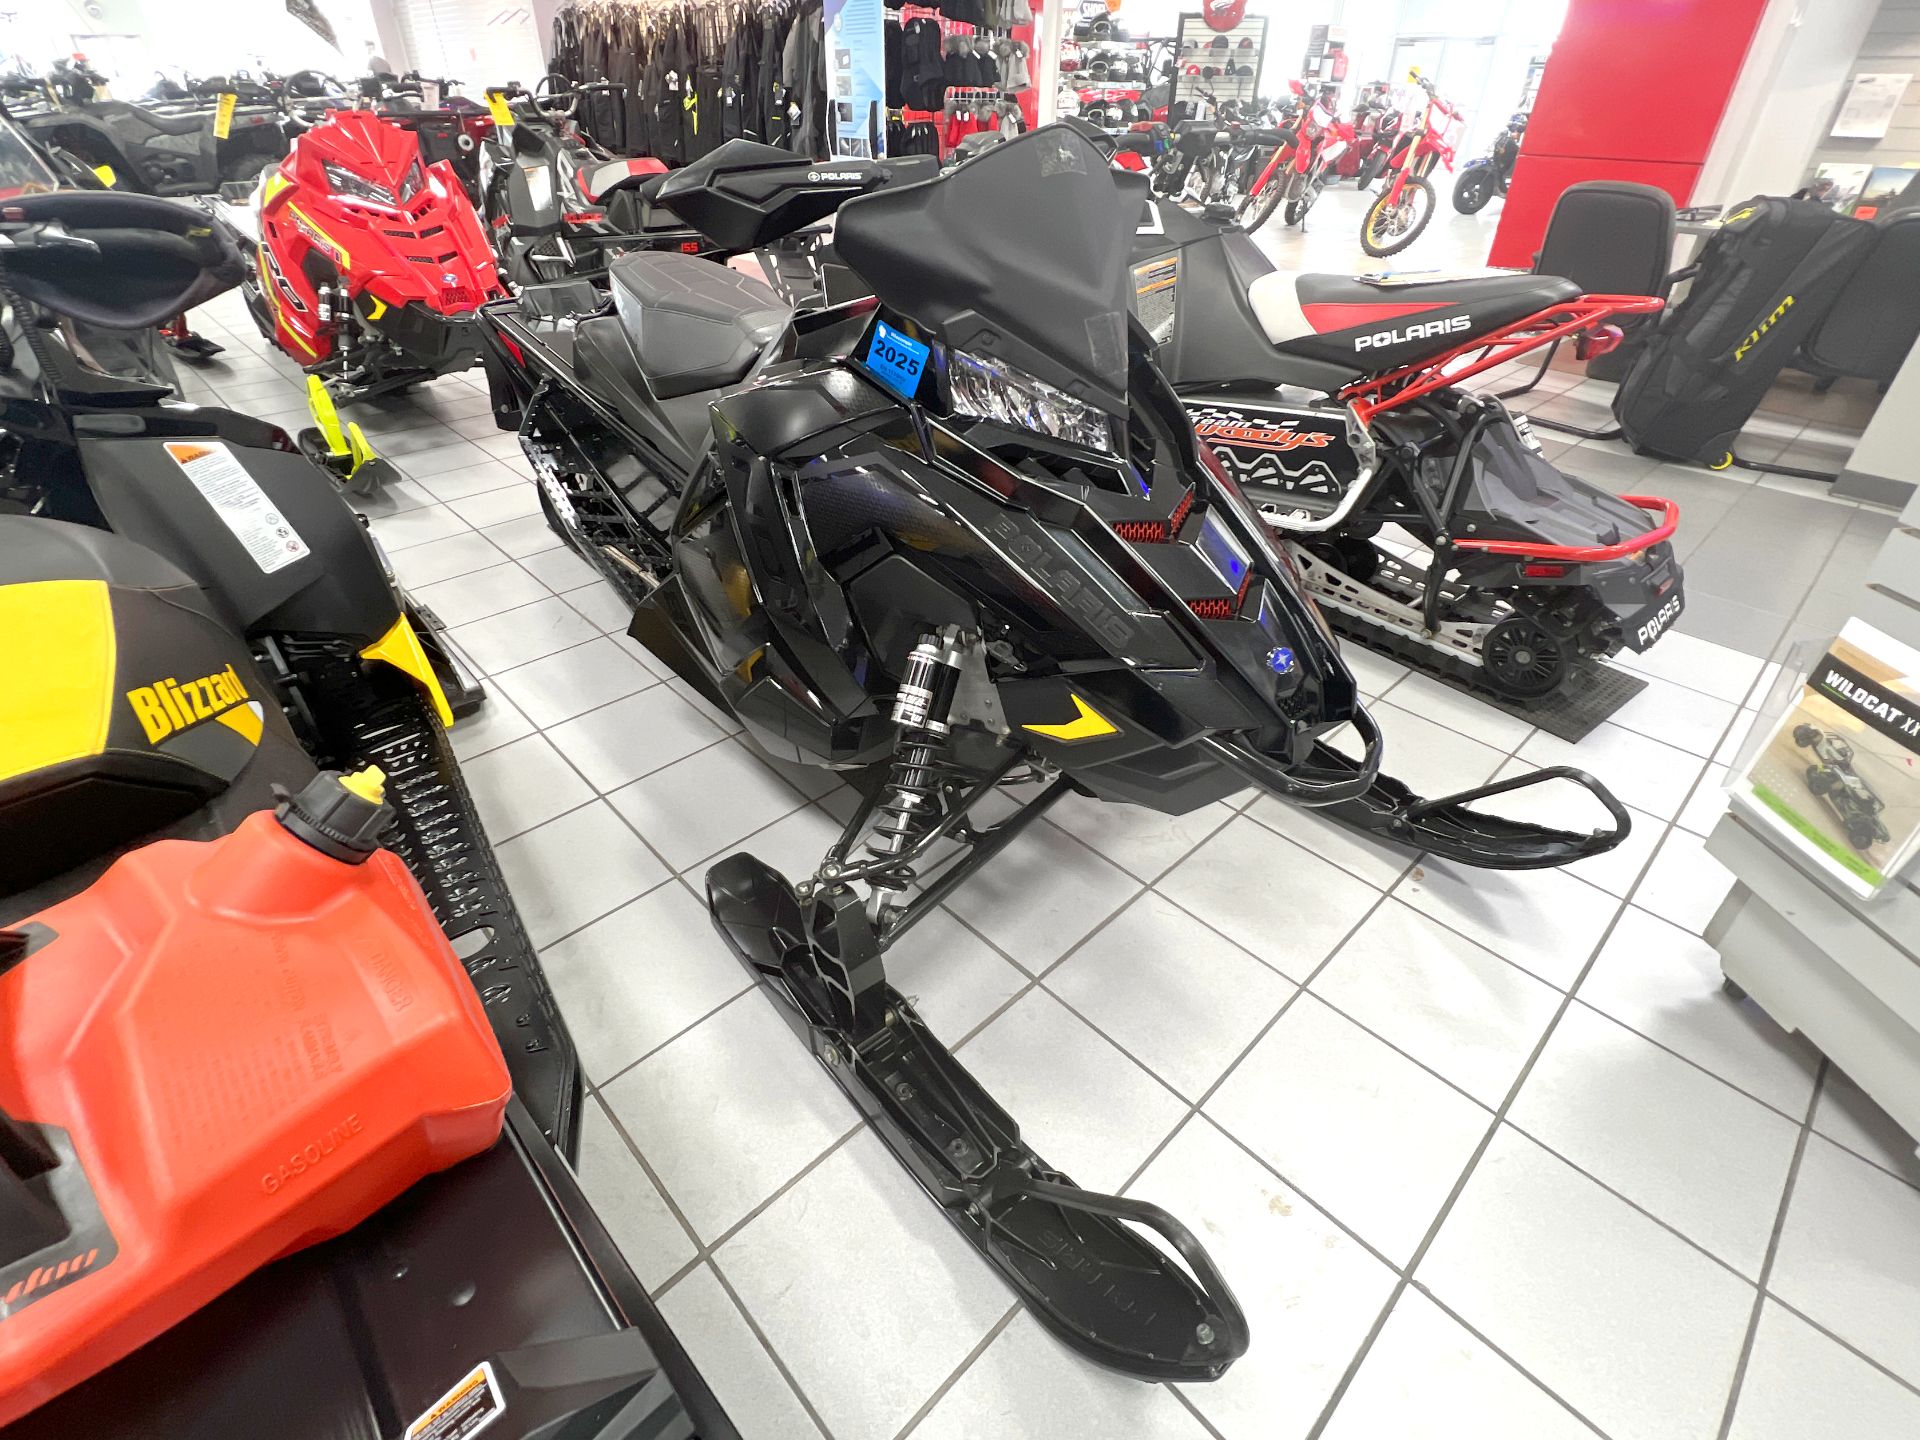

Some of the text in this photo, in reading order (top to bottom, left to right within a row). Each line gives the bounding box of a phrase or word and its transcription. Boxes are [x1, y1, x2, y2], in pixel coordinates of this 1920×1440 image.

[820, 172, 863, 181] POLARIS
[874, 340, 920, 376] 2025
[1354, 314, 1472, 353] POLARIS
[982, 512, 1136, 650] POLARIS
[1637, 594, 1681, 646] POLARIS
[126, 663, 249, 745] Blizzard
[1824, 669, 1903, 723] WILDCAT
[261, 1112, 364, 1195] GASOLINE
